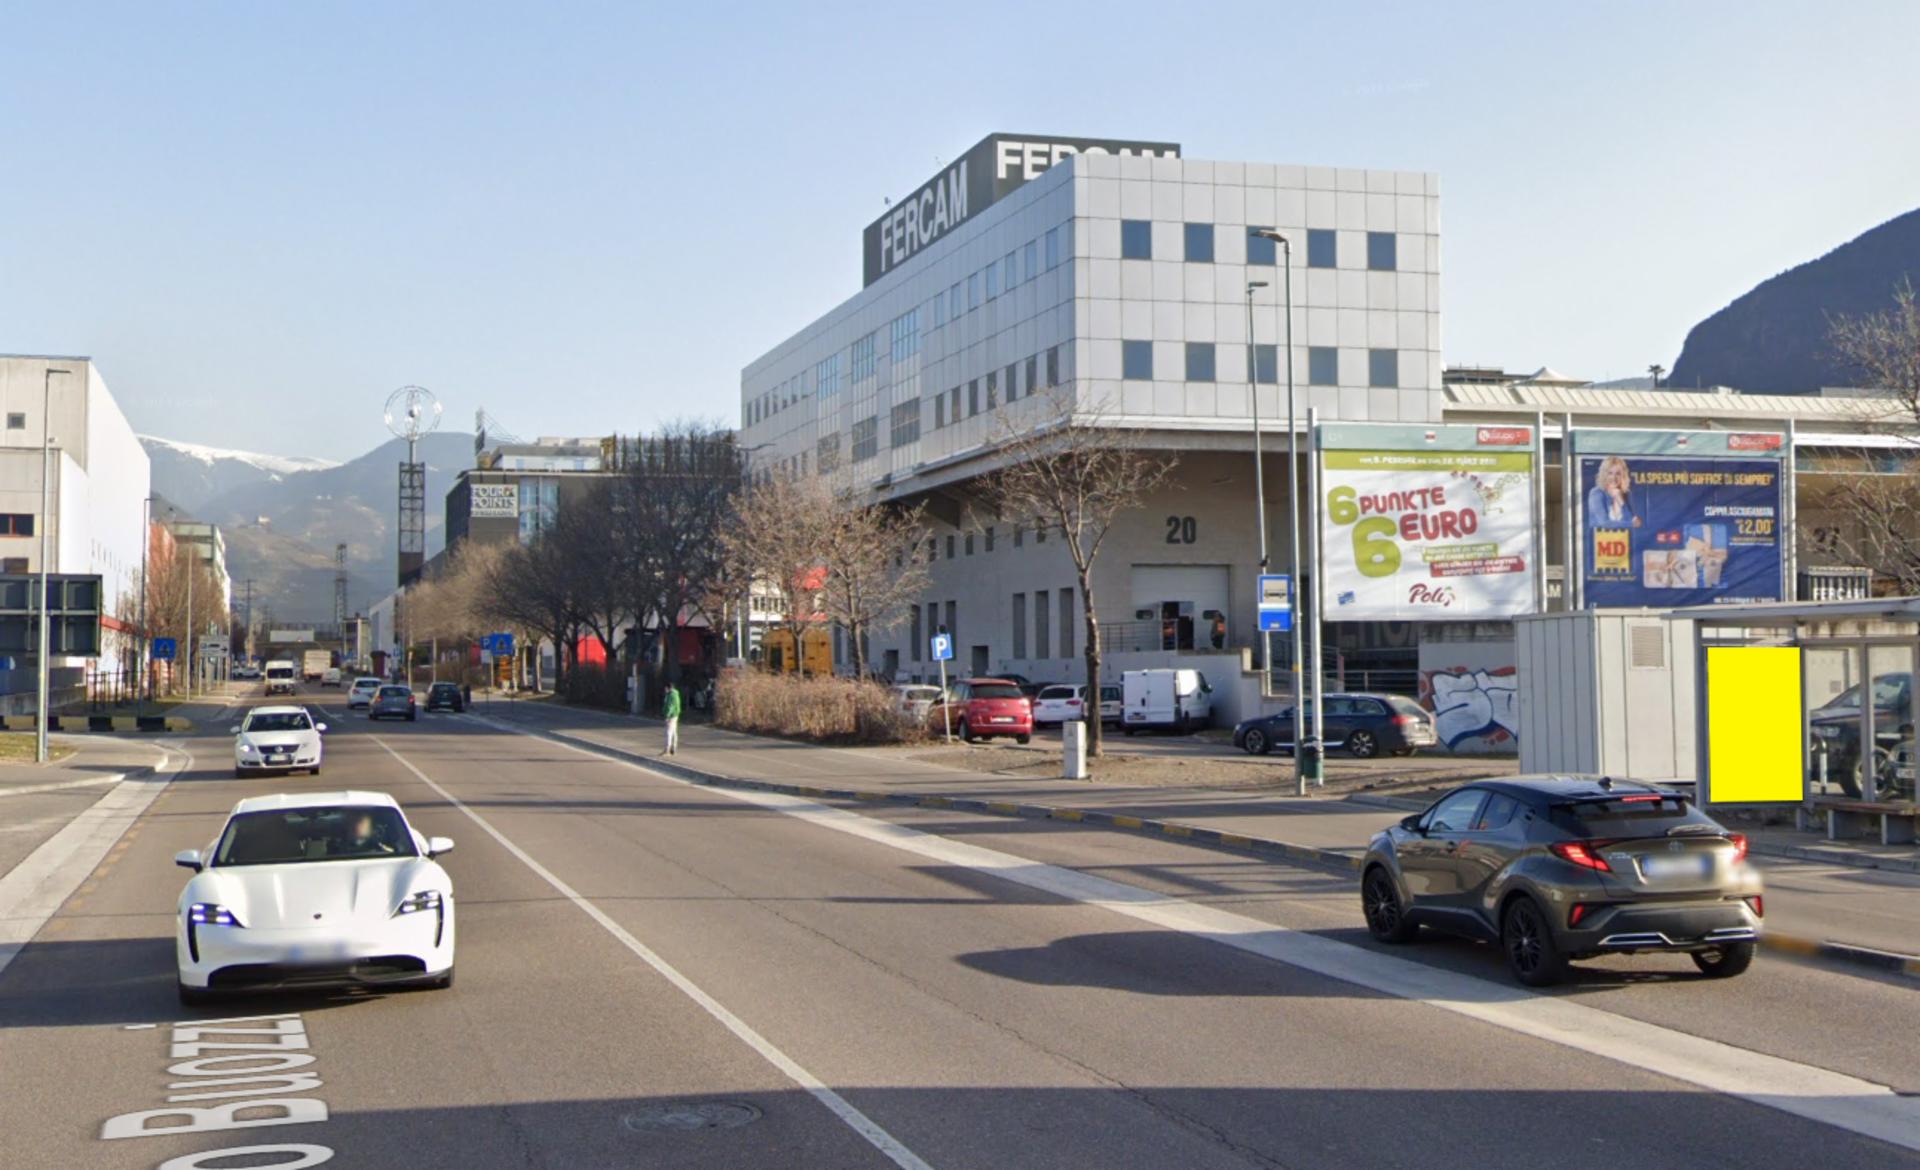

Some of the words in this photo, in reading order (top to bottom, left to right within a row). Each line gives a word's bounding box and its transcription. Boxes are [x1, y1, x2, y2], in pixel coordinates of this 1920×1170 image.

[880, 160, 968, 273] FERCAM
[1647, 472, 1673, 484] SPESA
[472, 497, 514, 509] POINTS
[1327, 485, 1359, 525] 6
[1359, 486, 1446, 515] PUNKTE
[1166, 516, 1196, 545] 20
[1352, 516, 1401, 578] 6
[1400, 508, 1478, 542] EURO
[1597, 541, 1626, 557] MD
[1409, 583, 1446, 604] Poli
[1813, 587, 1866, 601] FERCAM
[935, 636, 948, 655] P
